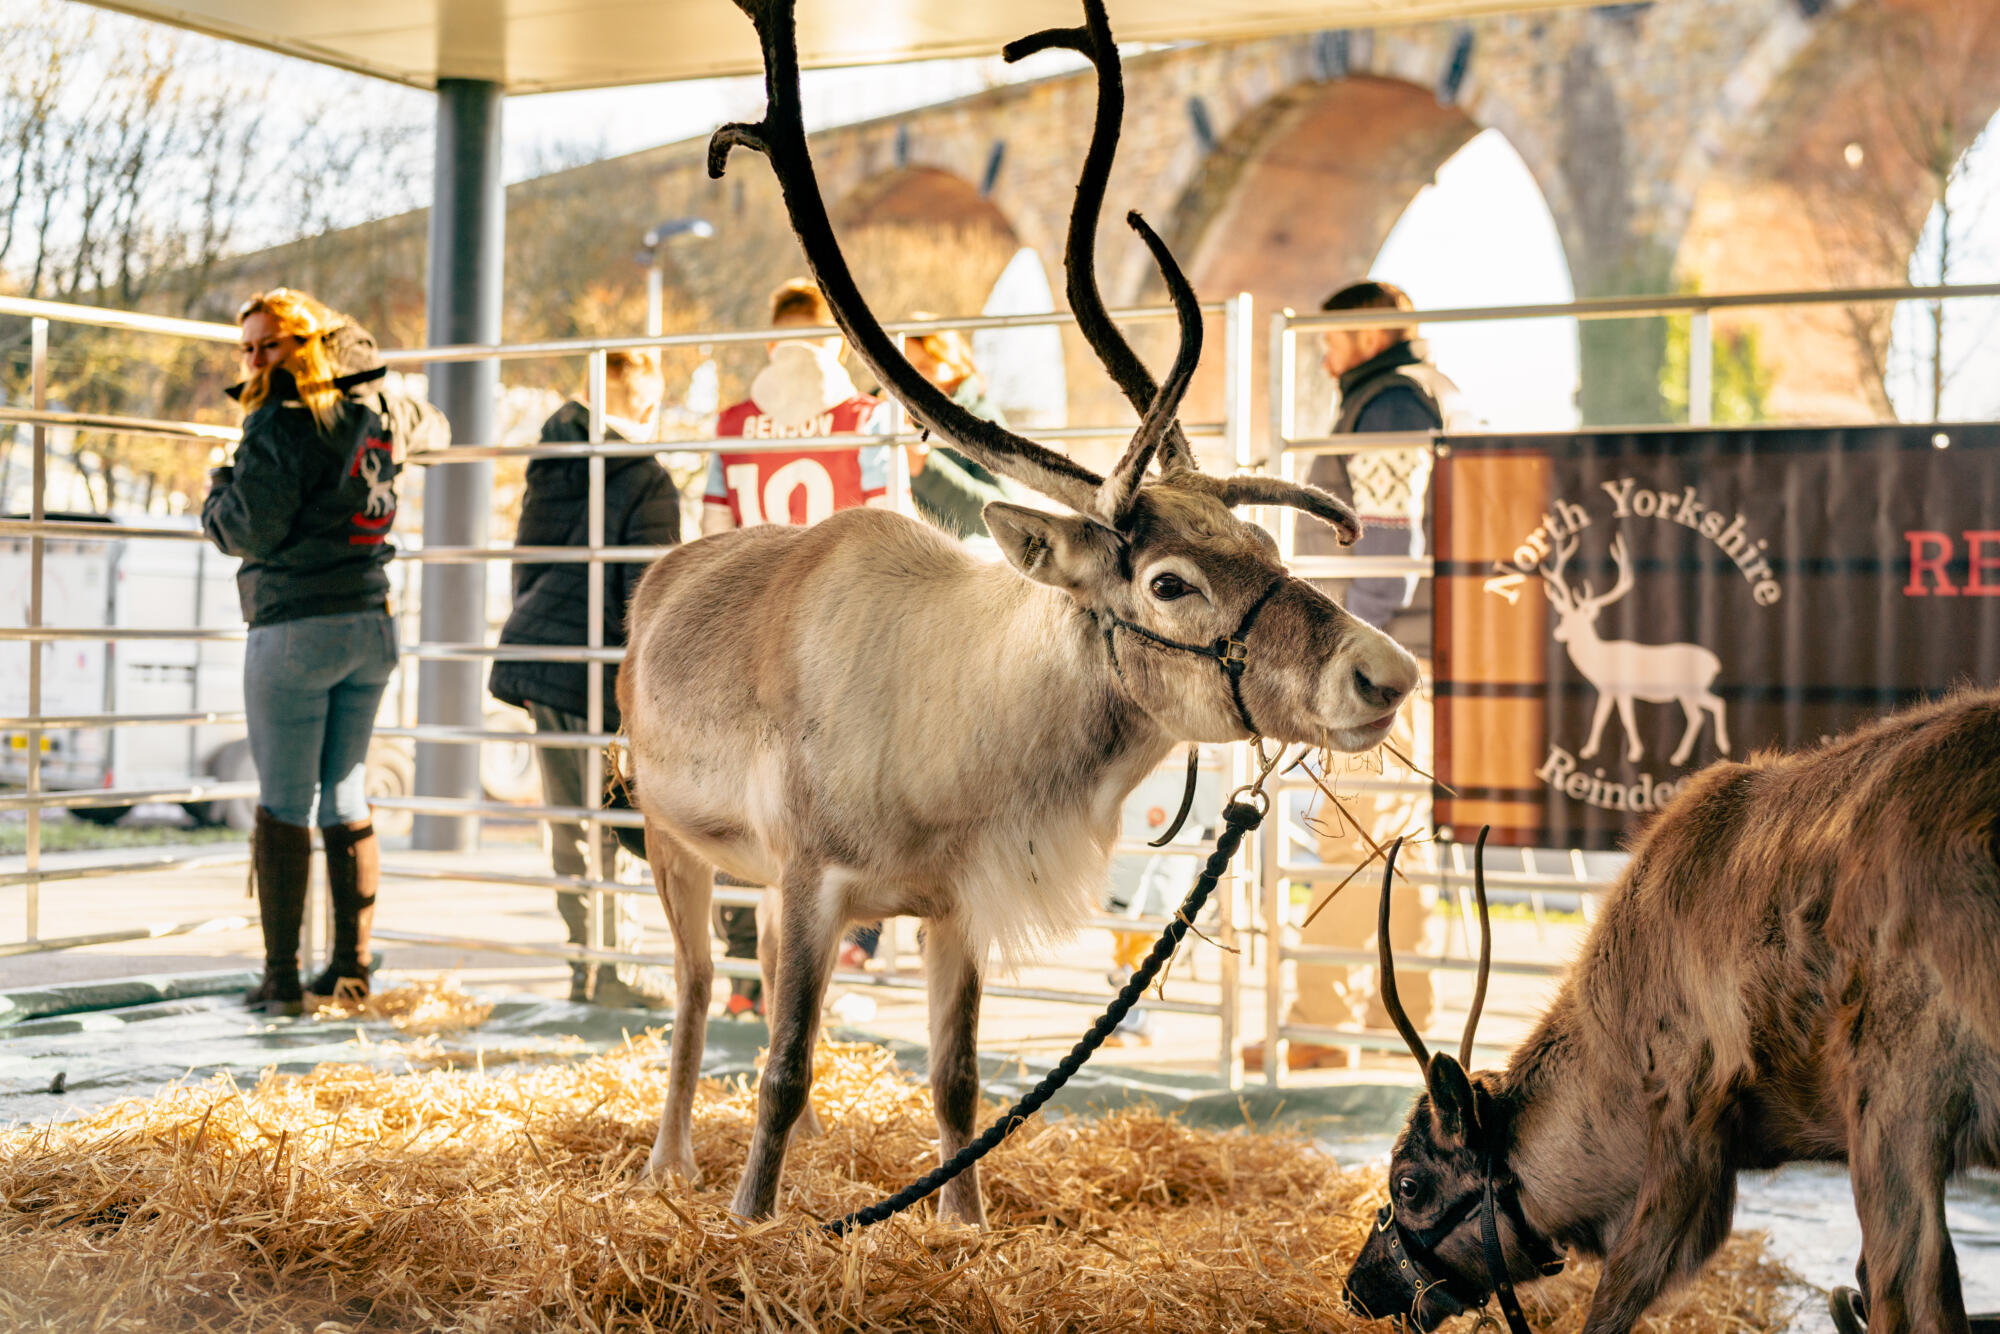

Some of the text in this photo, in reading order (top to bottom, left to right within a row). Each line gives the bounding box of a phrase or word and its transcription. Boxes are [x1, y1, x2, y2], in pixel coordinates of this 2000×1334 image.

[727, 458, 834, 528] 10
[1484, 478, 1782, 606] North Yorkshire
